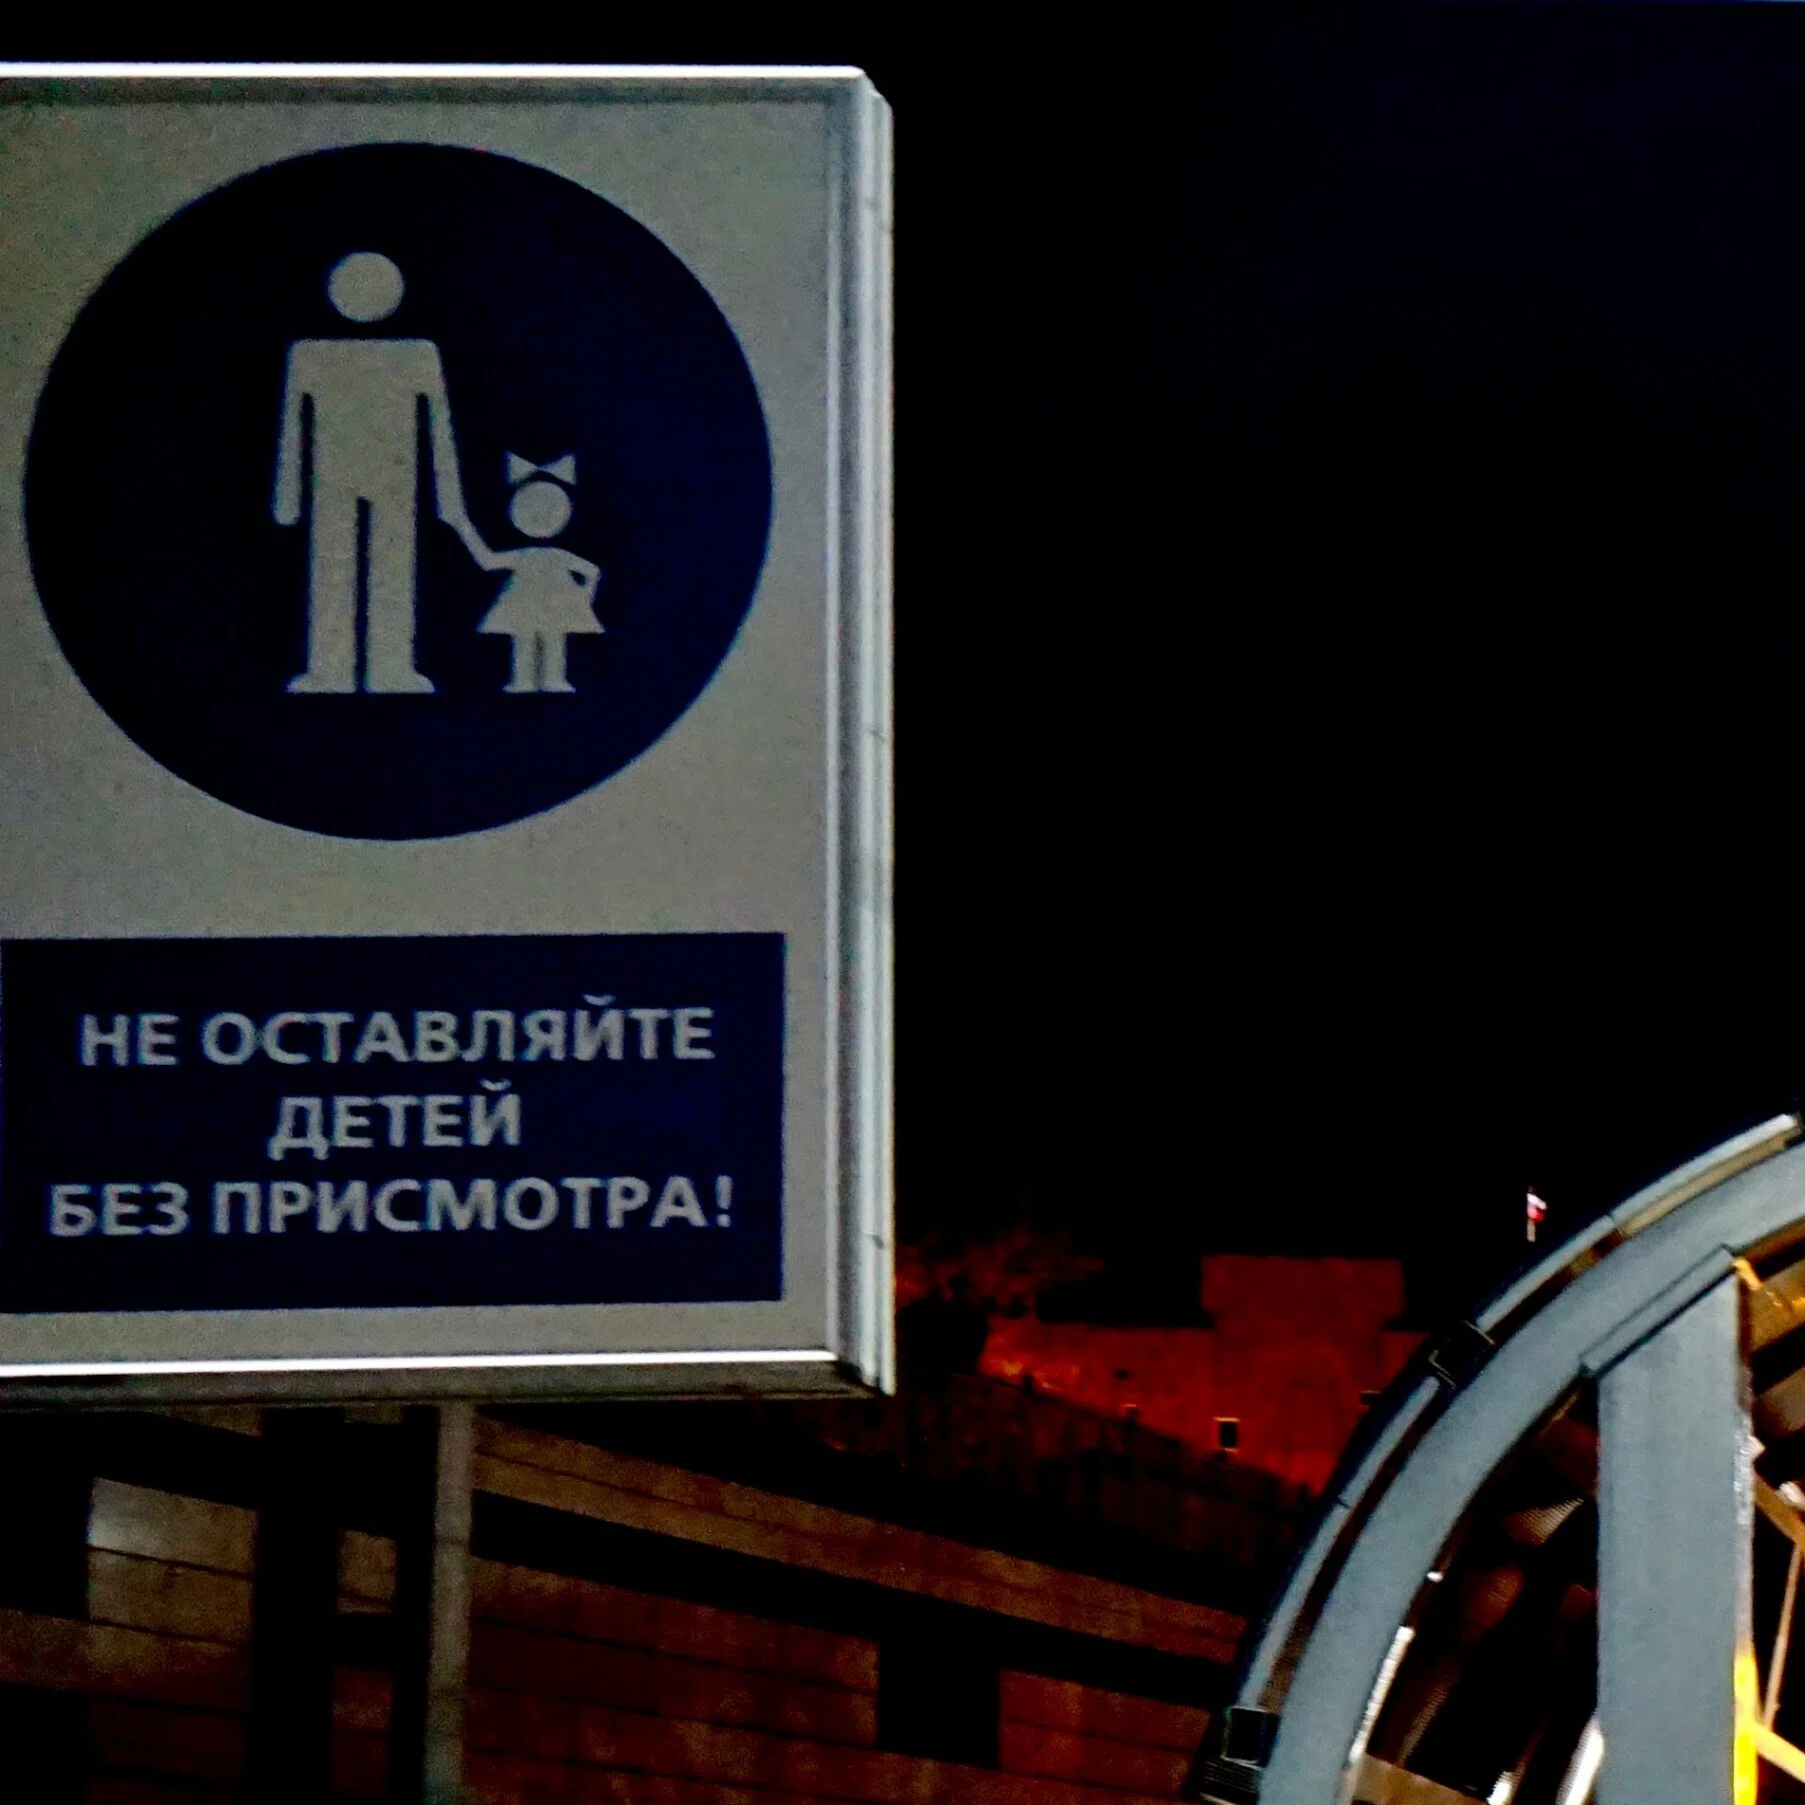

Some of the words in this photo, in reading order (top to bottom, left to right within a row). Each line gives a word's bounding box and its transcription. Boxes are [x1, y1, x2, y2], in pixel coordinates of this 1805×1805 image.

[79, 1012, 181, 1067] НЕ
[201, 993, 717, 1065] ОСТАВЛЯЙТЕ
[267, 1077, 523, 1162] ДЕТЕЙ
[47, 1181, 191, 1238] БЕЗ
[212, 1174, 735, 1235] ПРИСМОТРА!
